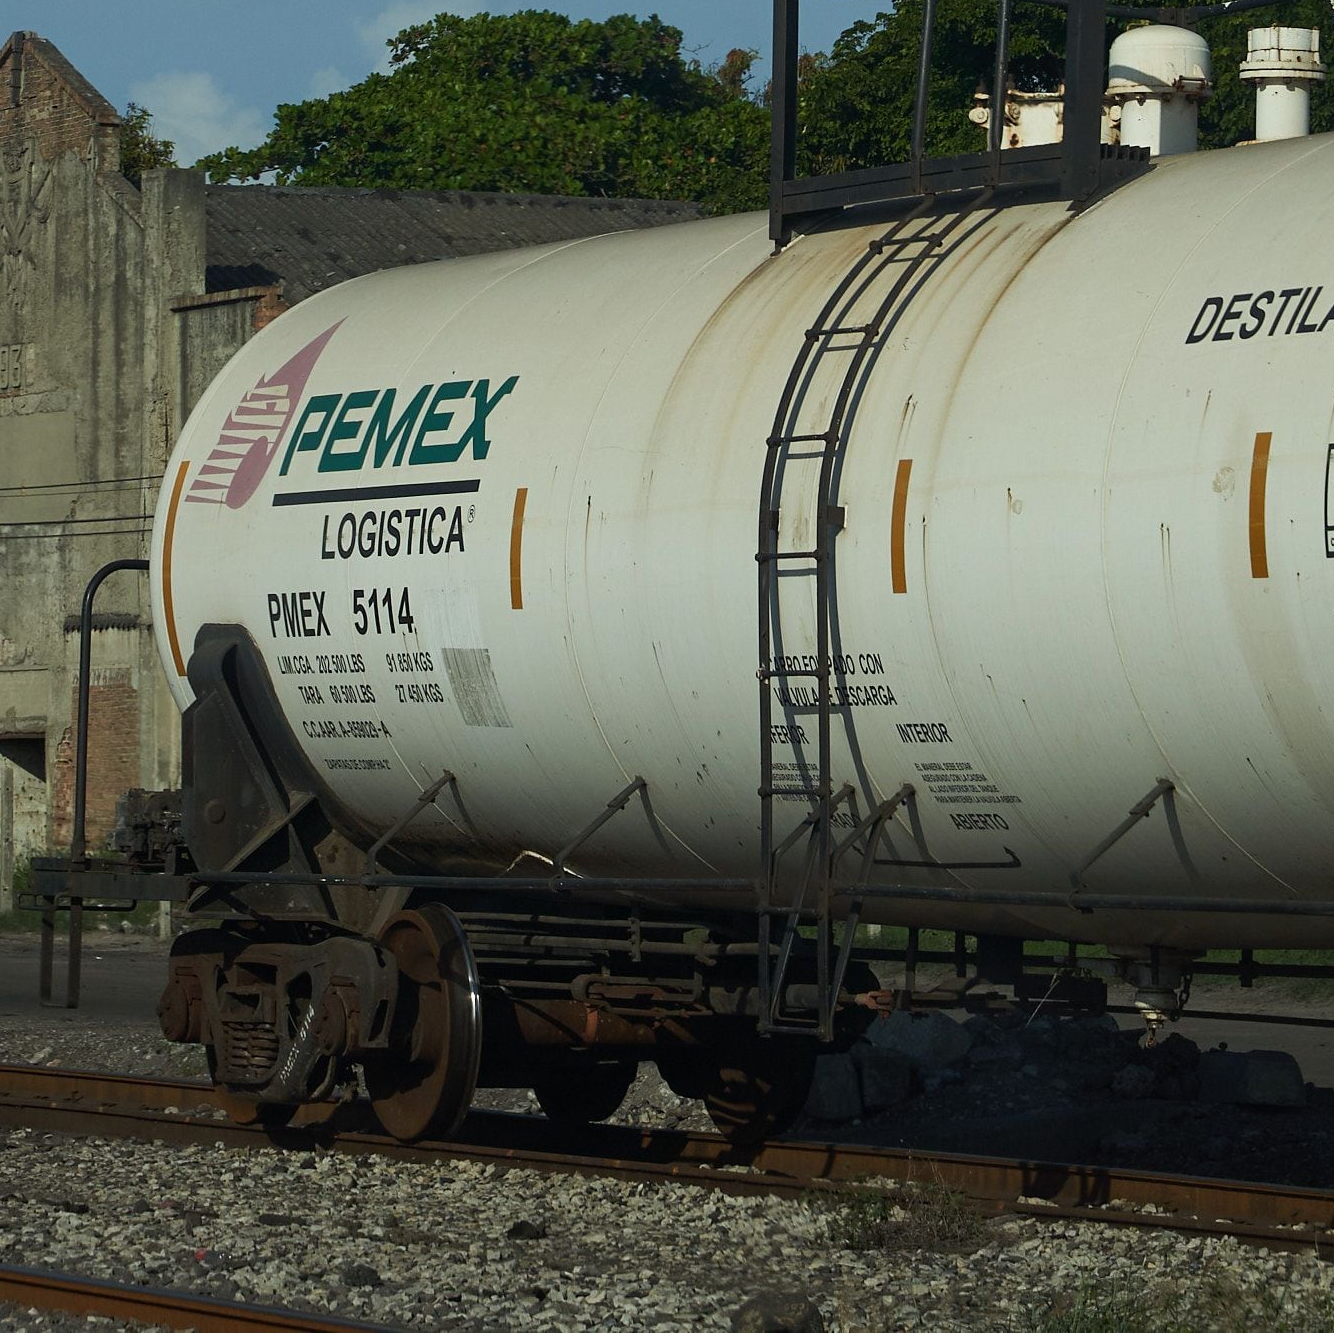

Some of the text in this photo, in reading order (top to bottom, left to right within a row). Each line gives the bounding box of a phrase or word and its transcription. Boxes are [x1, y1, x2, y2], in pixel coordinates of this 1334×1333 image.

[279, 376, 520, 476] PEMEX
[321, 506, 465, 560] LOGISTICA
[267, 587, 415, 638] PMEX 5114
[316, 655, 333, 674] 202
[331, 654, 348, 673] 500
[345, 653, 366, 673] LBS
[385, 653, 399, 673] 91
[397, 652, 415, 673] 850
[414, 651, 434, 672] KGS
[769, 655, 801, 672] ARRO
[859, 653, 885, 675] CON
[298, 683, 444, 705] TARA 60 500 LBS 27 450 KGS
[835, 685, 898, 707] DESCARGA
[771, 725, 810, 744] FERIOR
[896, 723, 953, 744] INTERIOR
[949, 813, 1010, 830] ABIERTO
